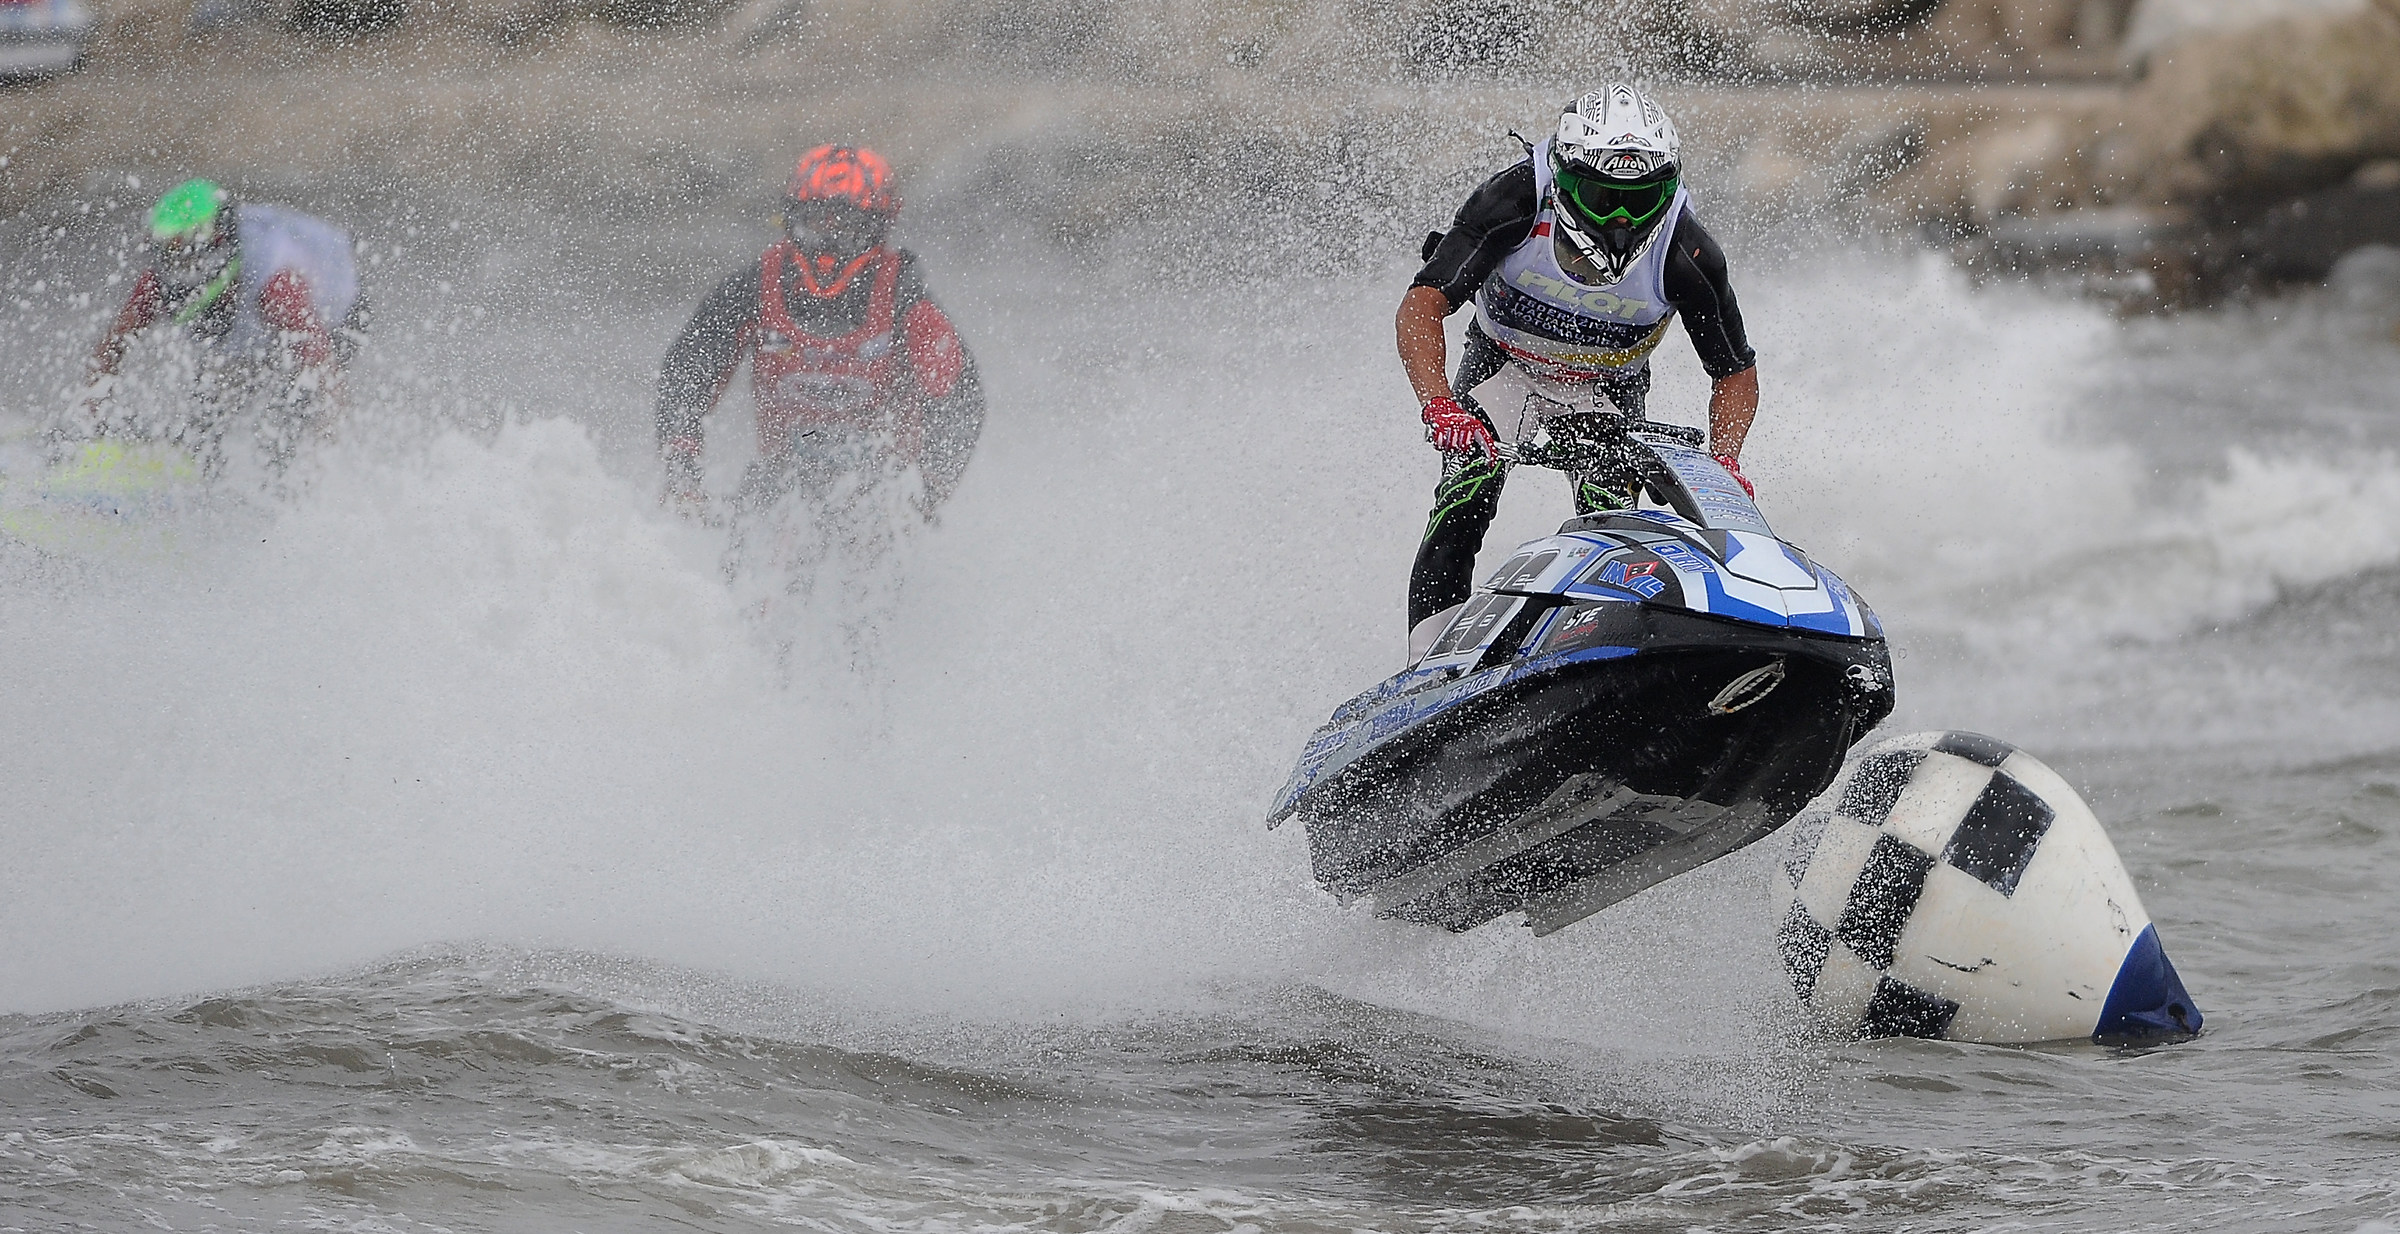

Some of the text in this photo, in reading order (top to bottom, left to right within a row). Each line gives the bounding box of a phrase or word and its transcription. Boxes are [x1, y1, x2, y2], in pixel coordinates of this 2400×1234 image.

[1605, 156, 1647, 171] Airoh
[1516, 269, 1648, 319] PILOT
[1519, 295, 1626, 336] FEDERAZIONE
